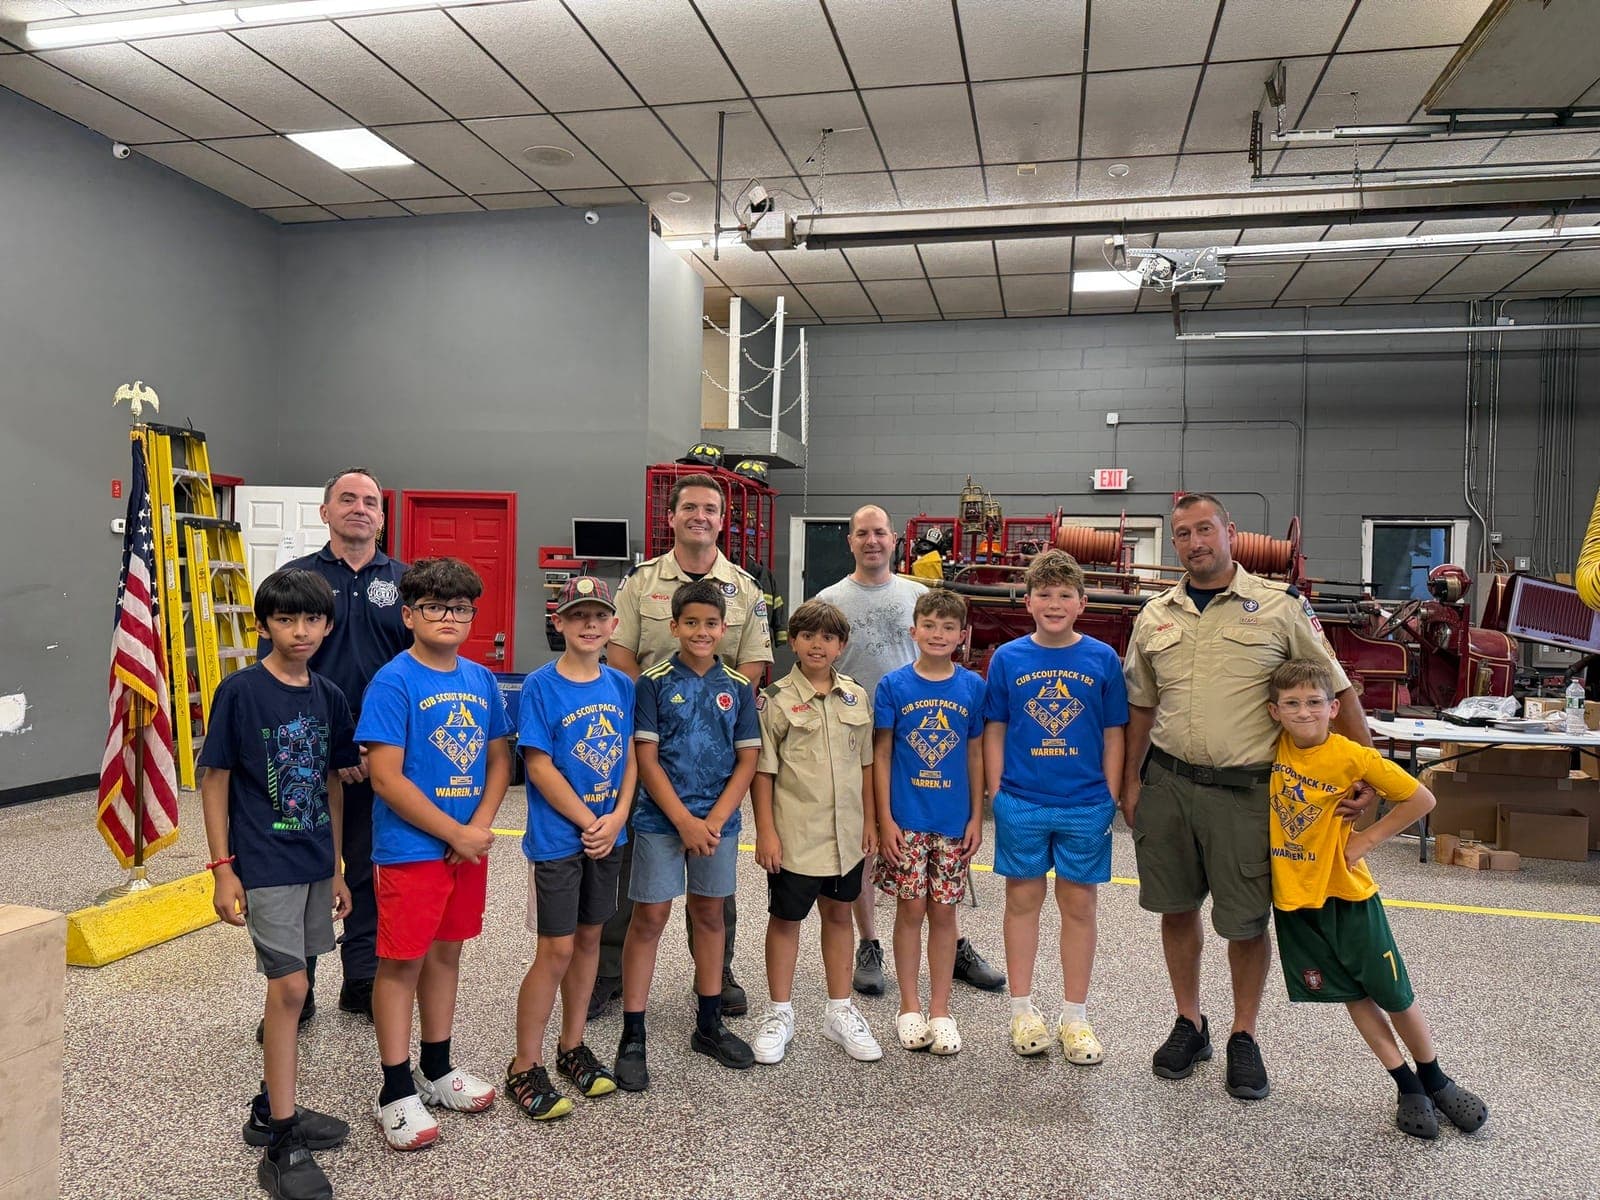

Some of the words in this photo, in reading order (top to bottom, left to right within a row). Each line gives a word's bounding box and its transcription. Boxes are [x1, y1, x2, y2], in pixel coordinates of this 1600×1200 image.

[1101, 470, 1123, 487] EXIT
[1016, 674, 1031, 686] CUB
[1031, 670, 1057, 680] SCOUT
[1058, 669, 1079, 680] PACK
[1080, 674, 1095, 686] 182
[419, 696, 436, 711] CUB
[435, 692, 457, 703] SCOUT
[458, 692, 478, 703] PACK
[901, 703, 914, 716] CUB
[915, 699, 938, 709] SCOUT
[939, 699, 958, 711] PACK
[562, 713, 577, 727] CUB
[576, 704, 598, 717] SCOUT
[598, 703, 617, 712] PACK
[1031, 747, 1067, 756] WARREN,
[1069, 747, 1079, 755] NJ
[943, 780, 952, 788] NJ
[1321, 783, 1338, 794] 182
[1382, 950, 1398, 981] 7
